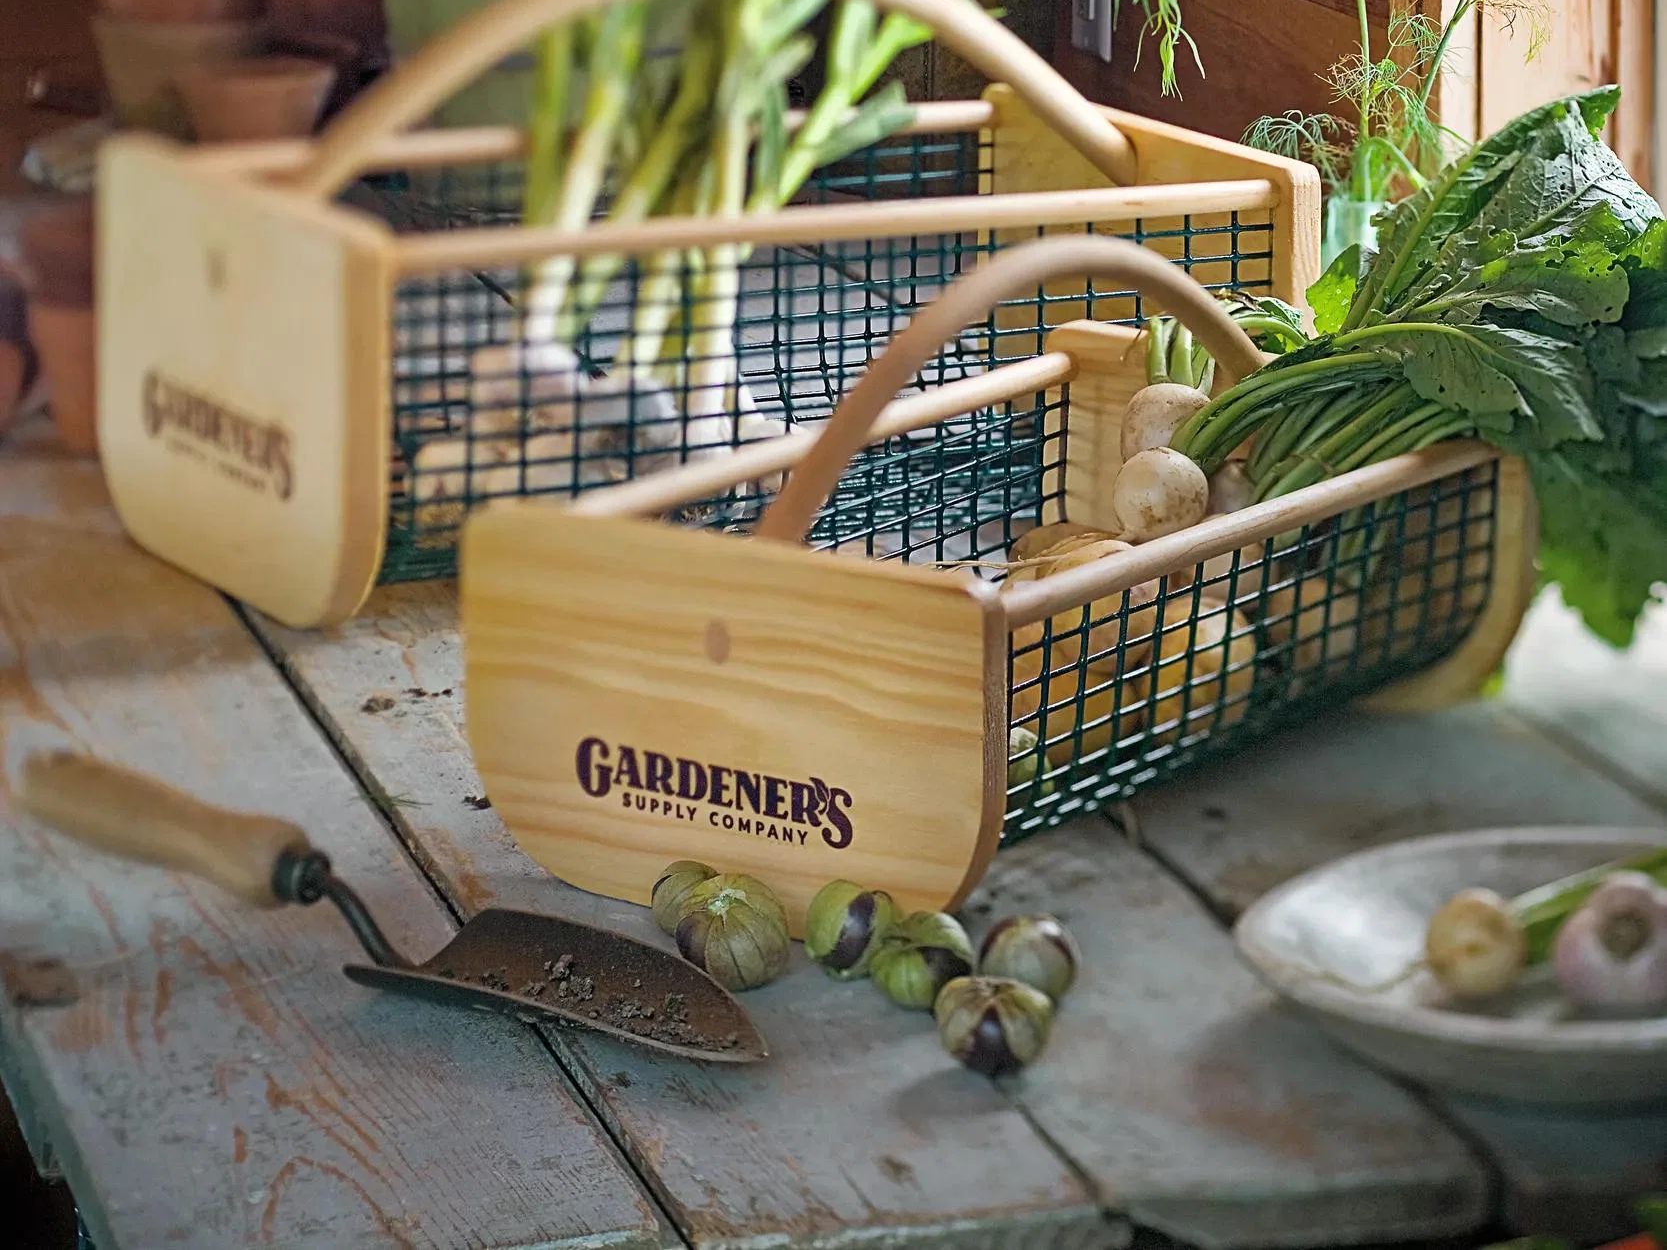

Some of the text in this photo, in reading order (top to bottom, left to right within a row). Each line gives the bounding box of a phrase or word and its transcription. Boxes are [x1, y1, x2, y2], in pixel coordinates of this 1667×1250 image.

[575, 736, 854, 850] GARDENER'S
[622, 791, 809, 847] SUPPLY COMPANY
